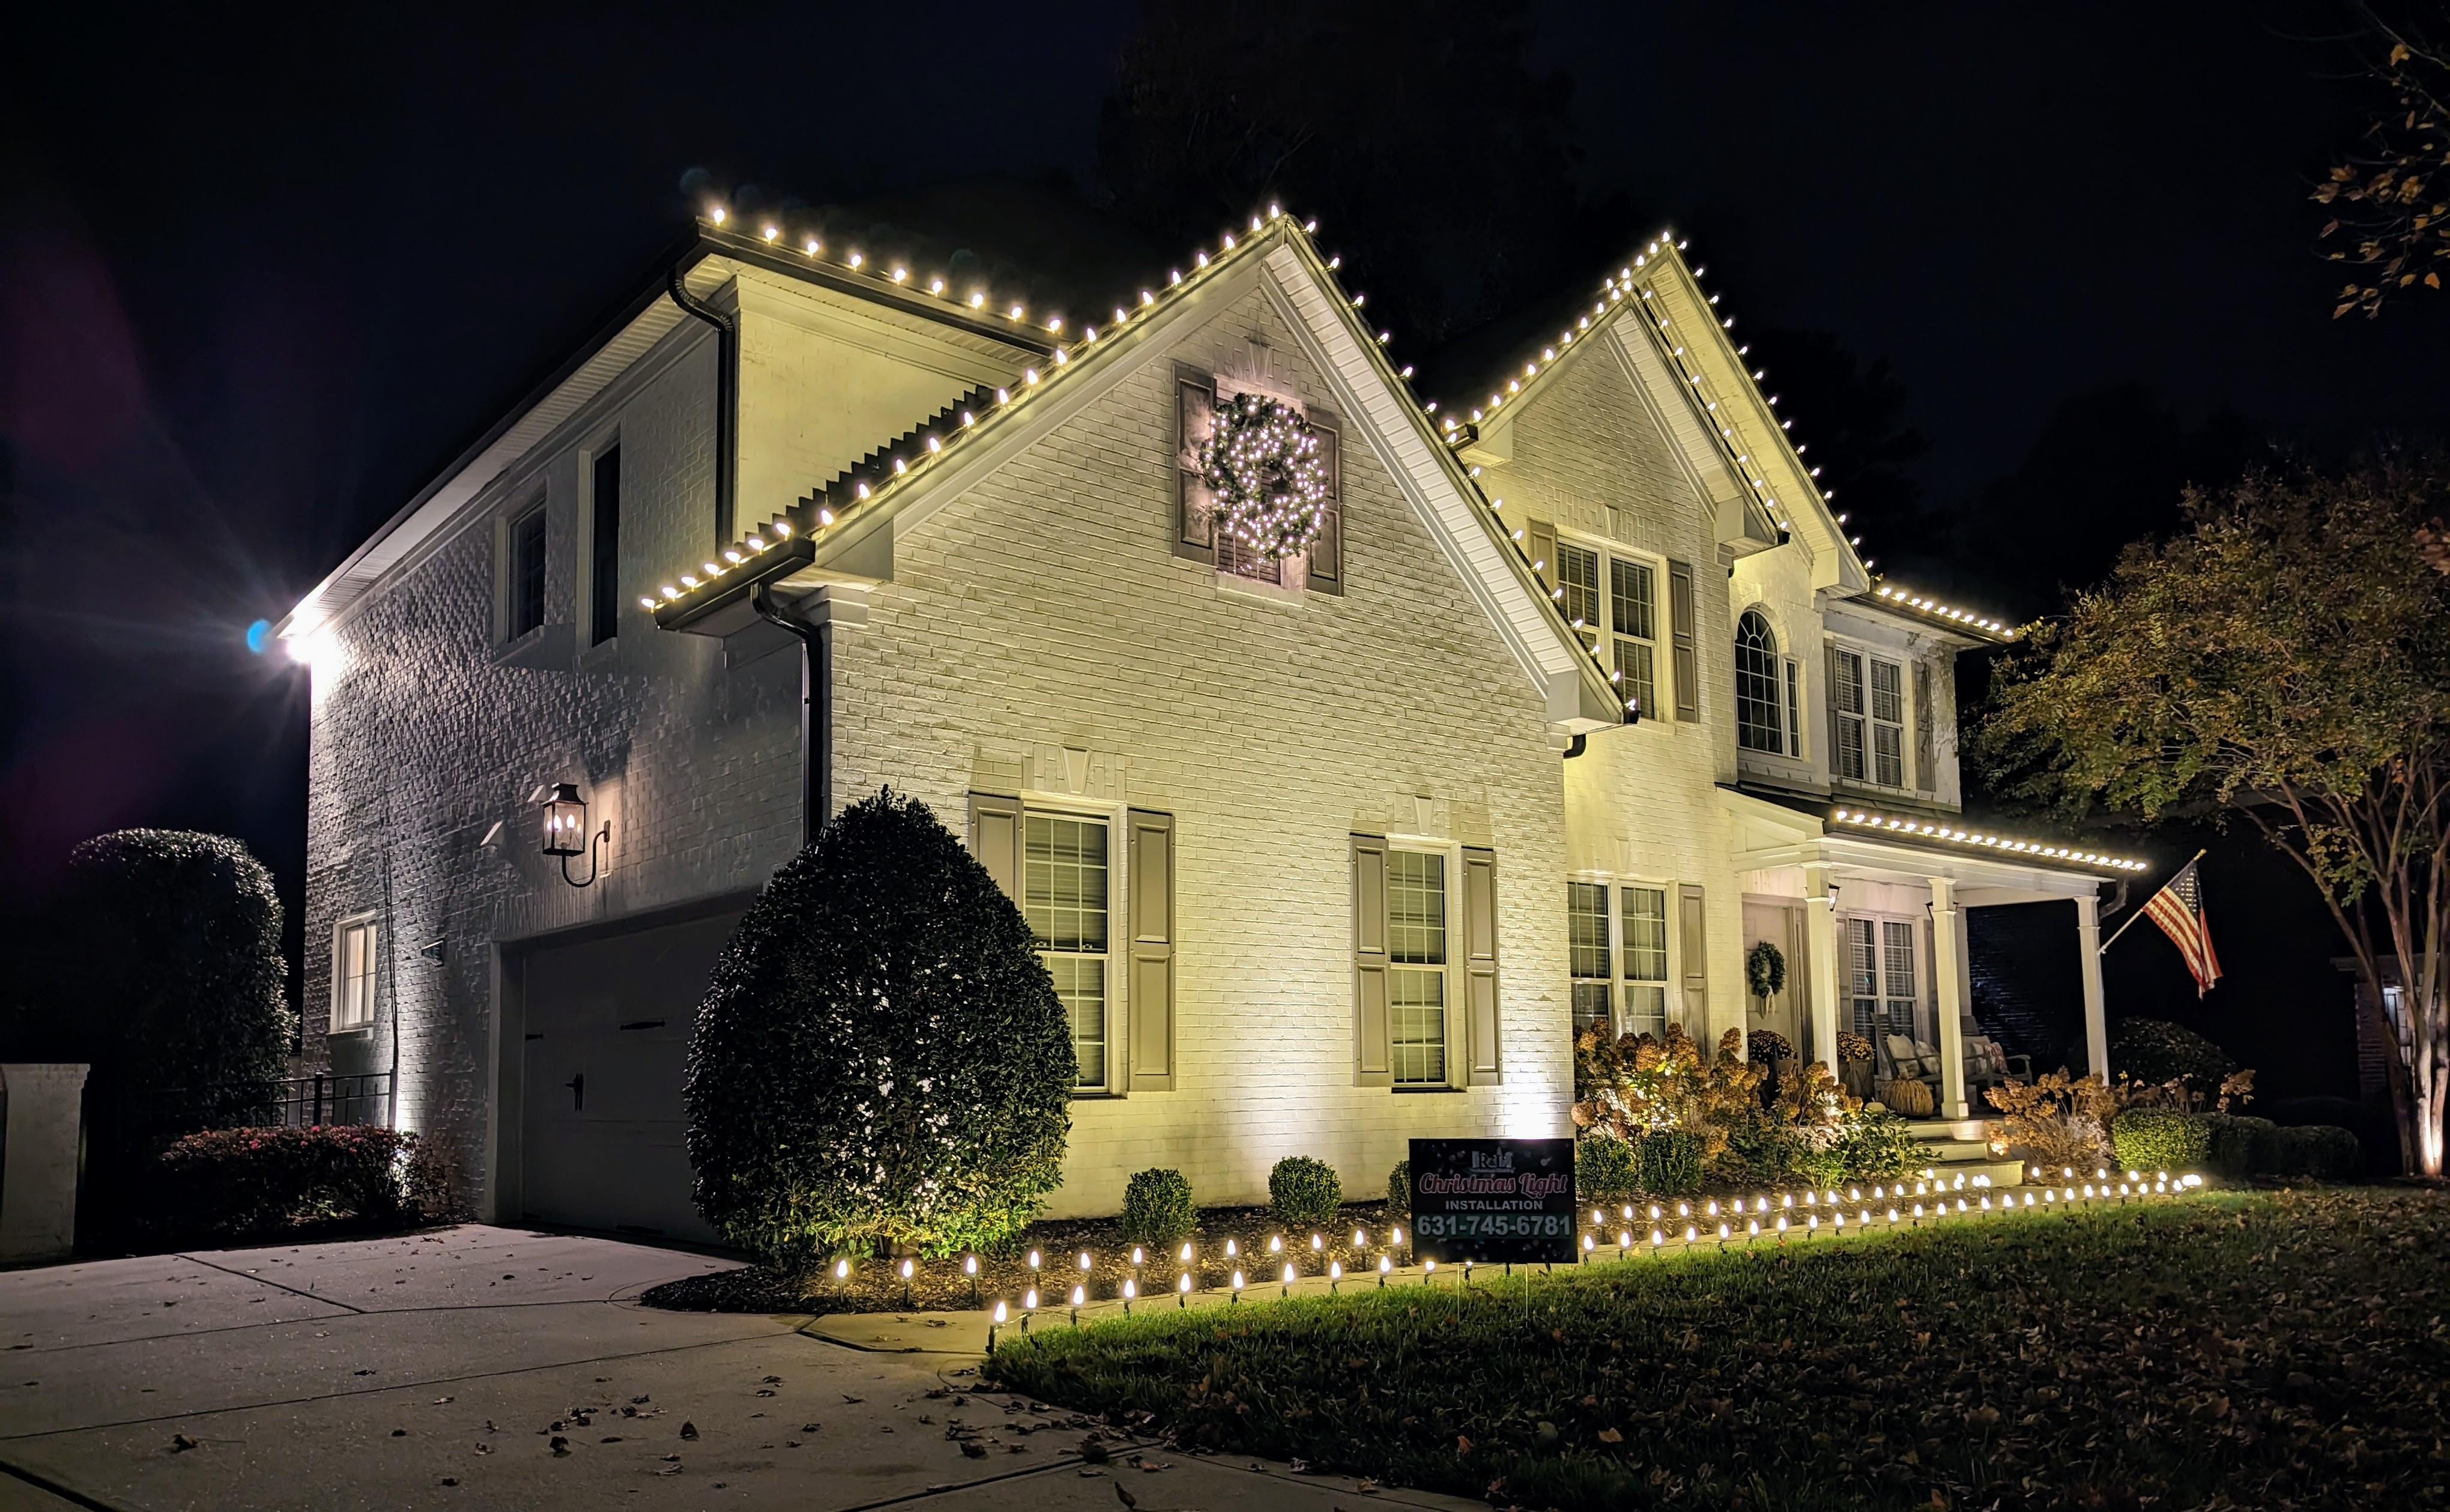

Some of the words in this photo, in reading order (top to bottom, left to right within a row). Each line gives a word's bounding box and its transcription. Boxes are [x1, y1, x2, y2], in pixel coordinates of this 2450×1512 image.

[1420, 1173, 1516, 1194] Christmas
[1519, 1173, 1568, 1199] Light
[1445, 1200, 1543, 1210] INSTALLATION
[1418, 1216, 1570, 1236] 631-745-6781
